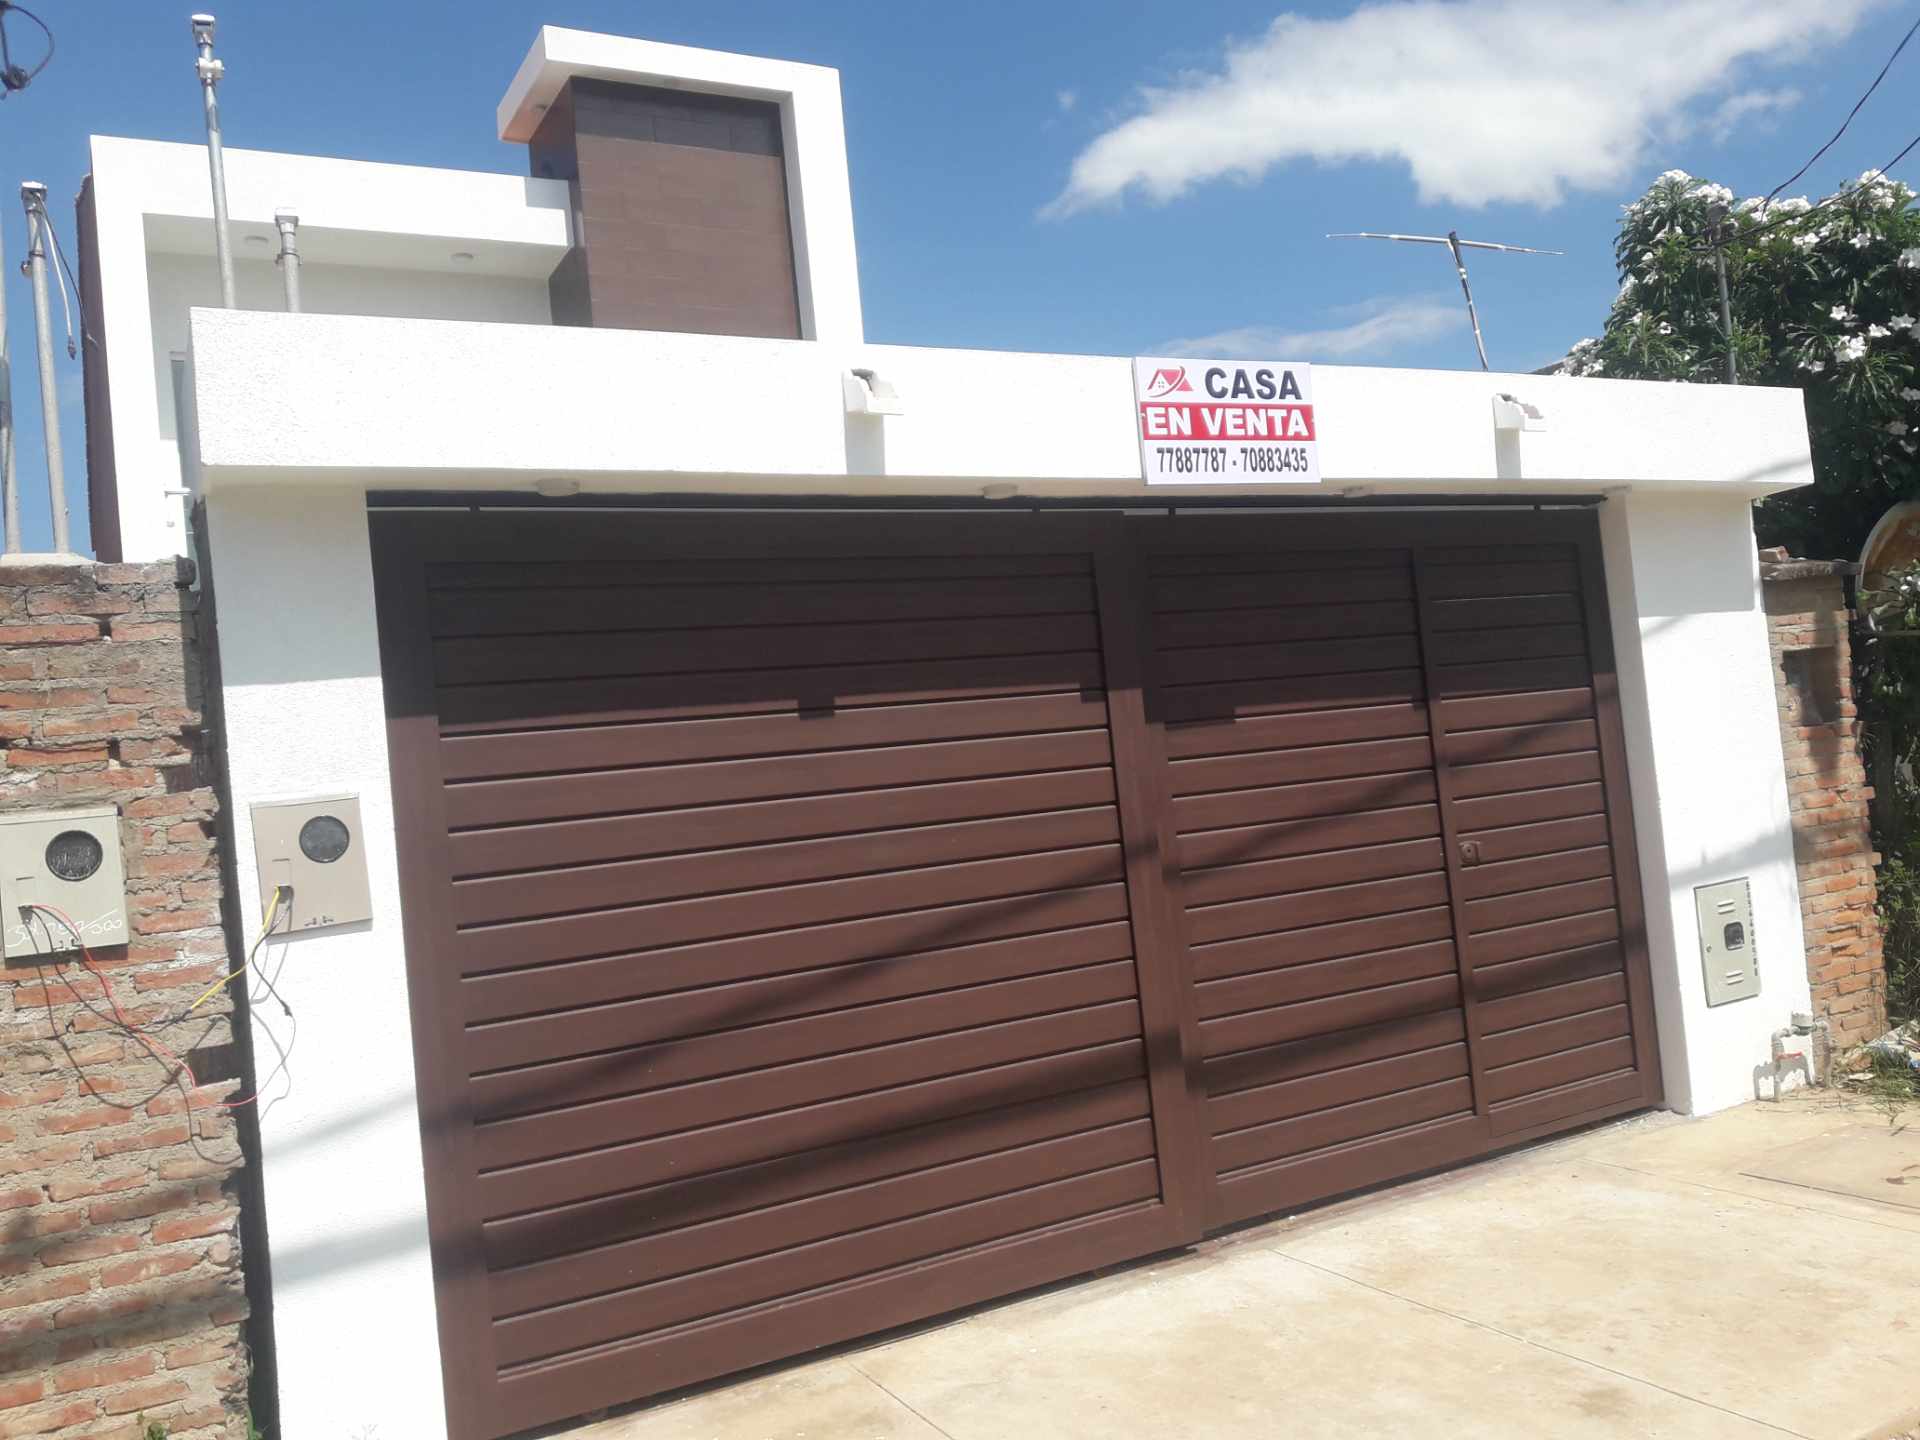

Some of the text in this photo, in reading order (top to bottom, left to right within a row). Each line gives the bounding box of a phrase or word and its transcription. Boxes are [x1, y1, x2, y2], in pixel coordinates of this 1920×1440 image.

[1204, 367, 1302, 400] CASA
[1146, 406, 1309, 436] EN VENTA
[1156, 447, 1227, 473] 77887787
[1240, 447, 1308, 473] 70883435
